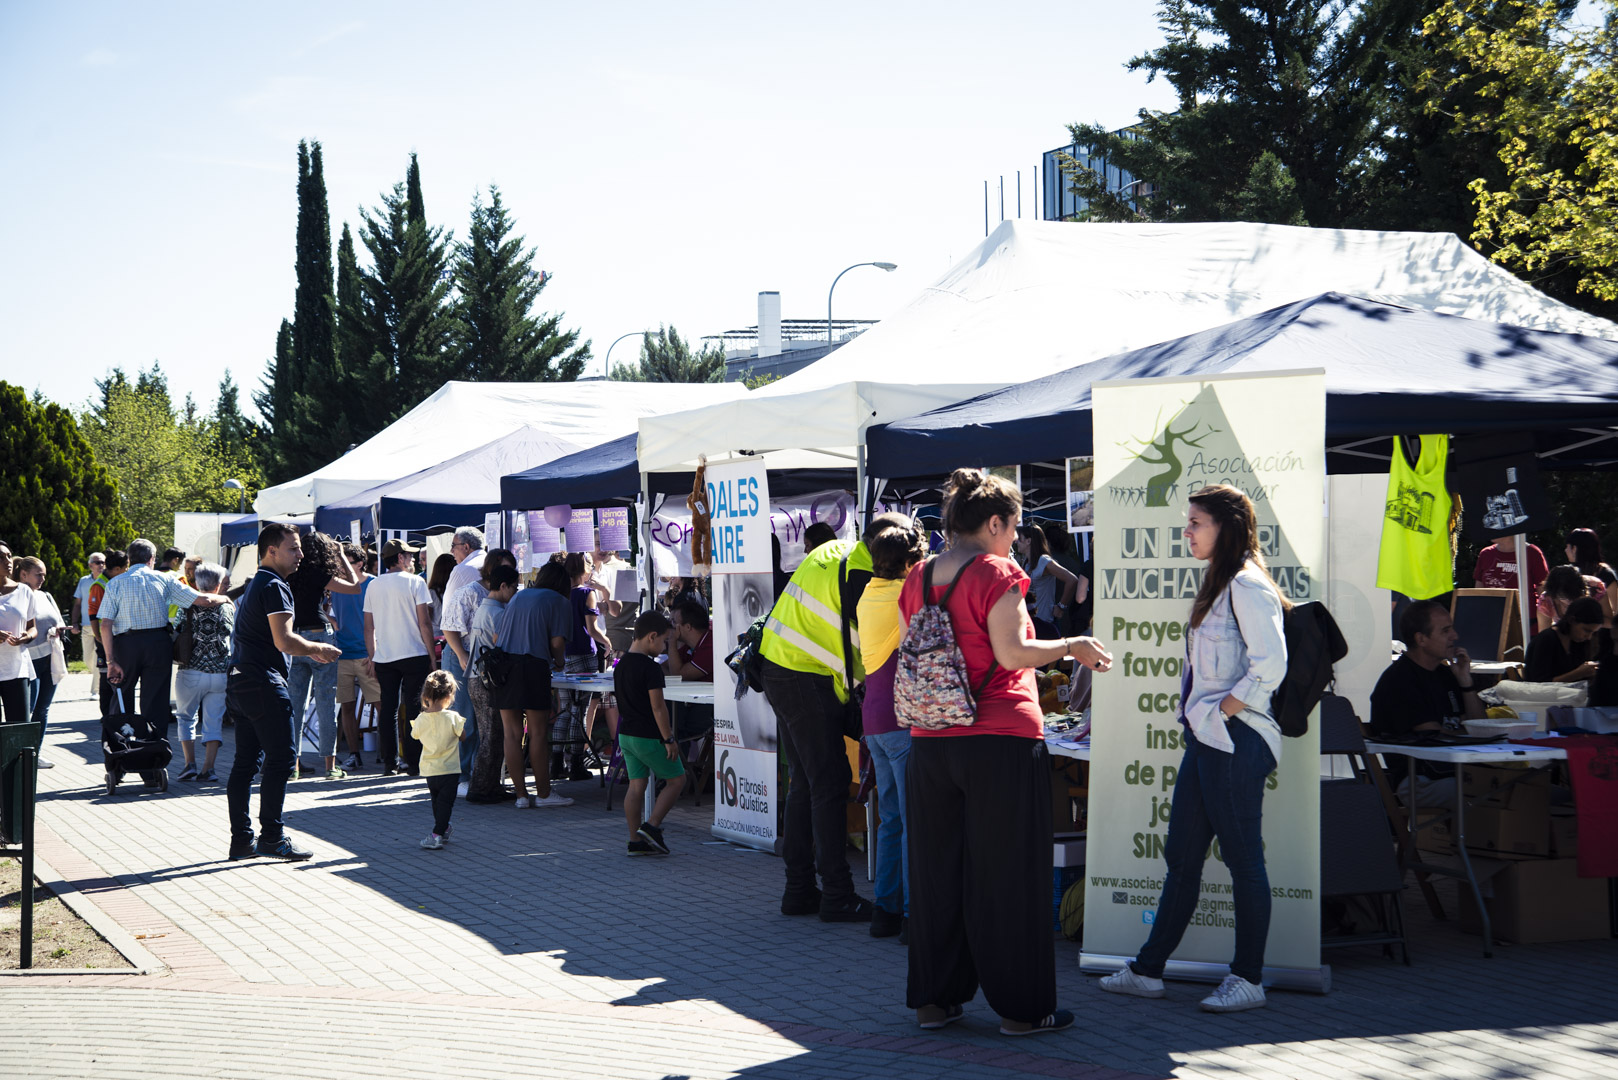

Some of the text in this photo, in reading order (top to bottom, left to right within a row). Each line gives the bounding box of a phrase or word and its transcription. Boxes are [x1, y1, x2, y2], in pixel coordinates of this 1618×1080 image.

[1187, 451, 1305, 477] Asociación
[1121, 527, 1159, 559] UN
[1100, 567, 1206, 600] MUCHA
[1125, 760, 1155, 786] de
[739, 777, 768, 797] Fibrosis
[739, 793, 769, 814] Quística
[717, 818, 774, 839] ASOCIACIÓN MADRILEÑA
